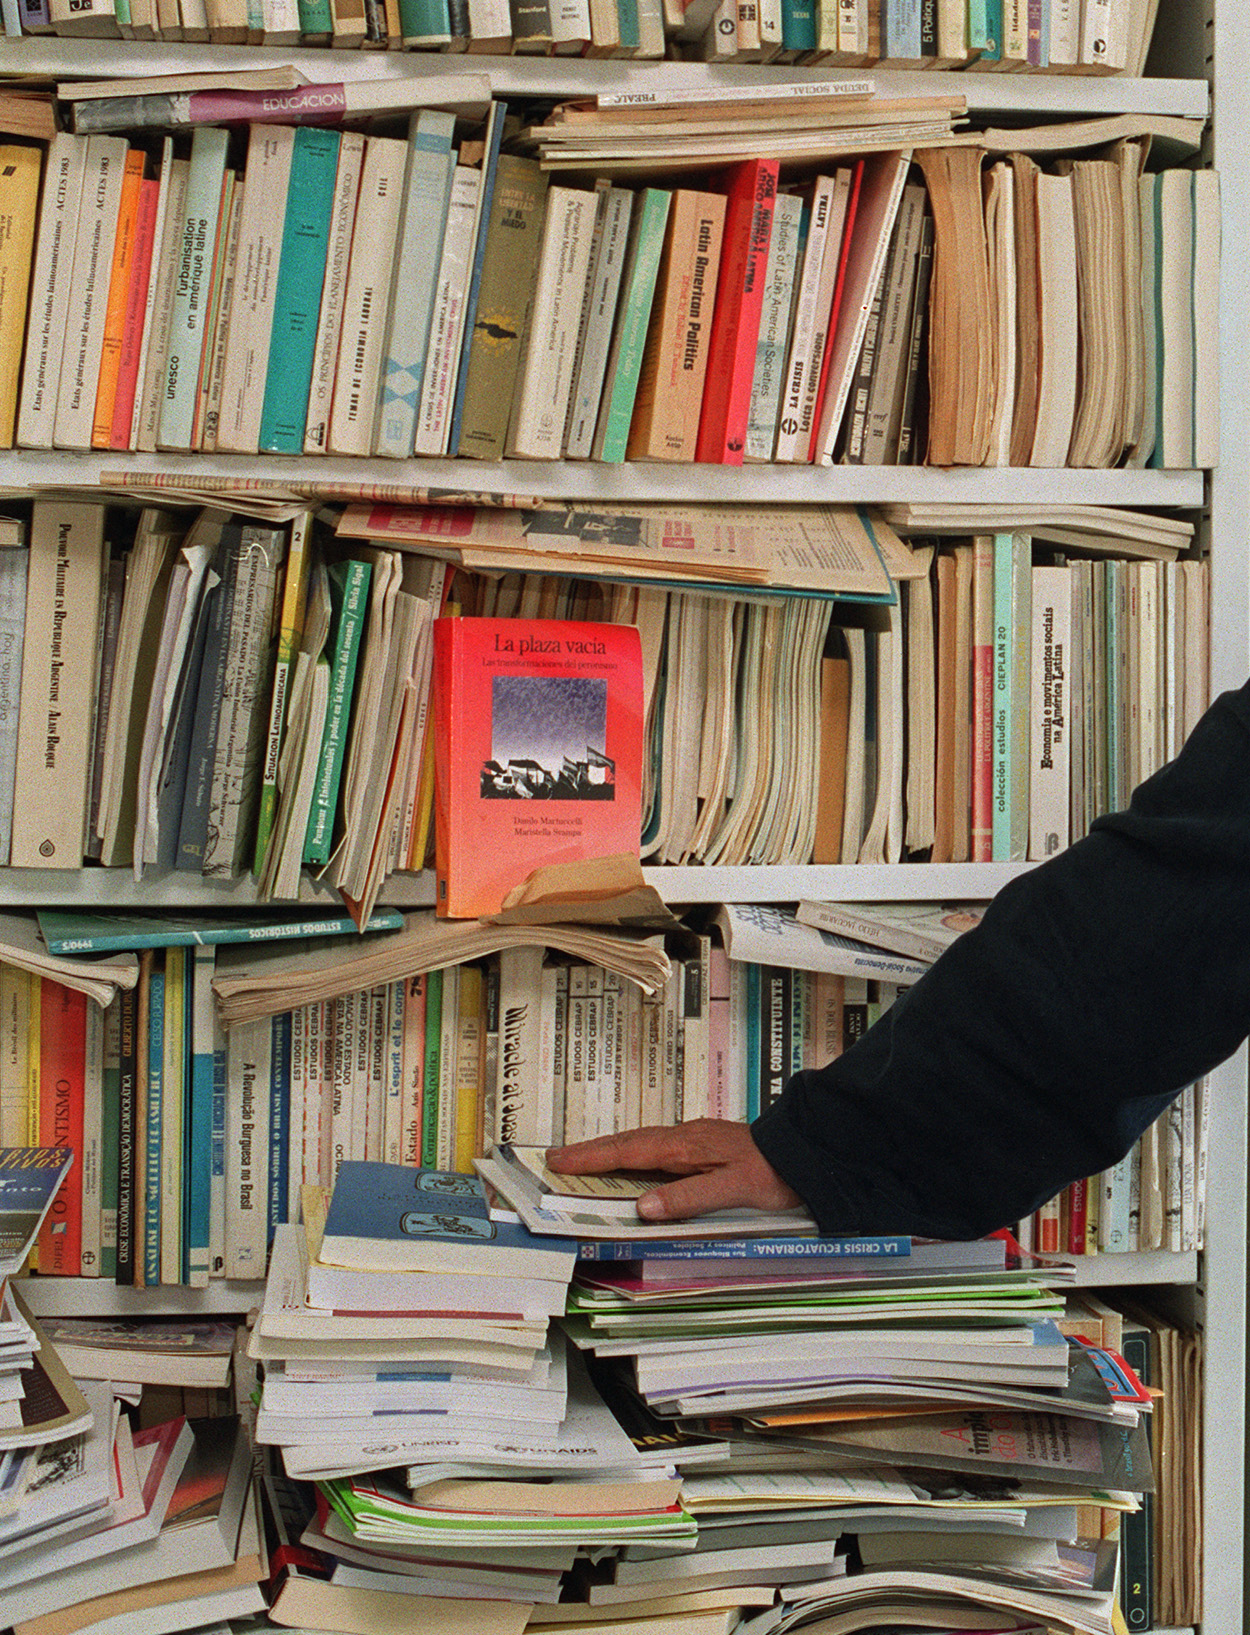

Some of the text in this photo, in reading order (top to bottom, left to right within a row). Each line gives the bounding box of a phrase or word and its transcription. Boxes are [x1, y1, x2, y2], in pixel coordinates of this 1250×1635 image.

[59, 157, 70, 176] 1983
[99, 157, 109, 176] 1983
[55, 179, 67, 210] ACTES
[95, 179, 107, 210] ACTES
[816, 195, 829, 228] LATINA
[176, 218, 195, 296] l'urbanisation
[187, 219, 208, 329] en amérique latine
[683, 220, 713, 371] Latin American Politics
[761, 214, 791, 396] Studies of Latin American Societies
[40, 336, 50, 347] sur
[42, 323, 51, 334] les
[79, 336, 88, 347] sur
[80, 323, 90, 333] les
[348, 287, 373, 421] TEMAS DE ECONOMIA LABORAL
[166, 356, 180, 399] unesco
[789, 361, 803, 408] LA CRISIS
[350, 565, 363, 585] Sigal
[346, 587, 360, 609] Silvia
[340, 621, 355, 648] sesenta
[494, 634, 514, 653] La
[520, 635, 561, 657] plaza
[1042, 607, 1053, 643] sociais
[338, 650, 351, 663] del
[1042, 646, 1053, 707] movimentos
[331, 704, 343, 714] en
[1052, 644, 1064, 743] na América Latina
[328, 717, 342, 739] poder
[996, 626, 1006, 812] colección estudios CIEPLAN 20
[1040, 718, 1053, 769] Economia
[514, 816, 538, 826] Danilo
[357, 991, 368, 1071] ESTUDOS CEBRAP
[555, 995, 563, 1031] CEBRAP
[588, 1001, 597, 1038] CEBRAP
[604, 975, 616, 1075] ESTUDOS CEBRAP 20
[293, 1006, 302, 1081] ESTUDOS CEBRA
[310, 1001, 319, 1080] ESTUDOS CEBRA
[373, 1000, 383, 1081] ESTUDOS CEBRAP
[389, 982, 403, 1096] L'esprit et le corps
[554, 1034, 563, 1075] ESTUDOS
[574, 1002, 582, 1082] ESTUDOS CEBRAP
[770, 978, 783, 1094] NA CONSTITUINTE
[324, 1039, 332, 1081] ESTUDOS
[501, 1004, 529, 1144] Miracle at Joas
[588, 1040, 596, 1081] ESTUDOS
[121, 1074, 132, 1133] DEMOCRÁTICA
[241, 1074, 256, 1120] Revolução
[273, 1091, 282, 1129] BRASIL
[120, 1135, 132, 1179] TRANSIÇÃO
[238, 1123, 254, 1166] Burguesa
[405, 1120, 418, 1163] Estado
[242, 1169, 253, 1181] no
[120, 1190, 131, 1236] ECONÔMICA
[240, 1184, 254, 1210] Brasil
[271, 1182, 280, 1226] ESTUDOS
[119, 1239, 131, 1263] CRISE
[753, 1242, 898, 1254] LA CRISIS ECUATORIANA:
[941, 1427, 971, 1443] A
[1133, 1584, 1141, 1594] 2
